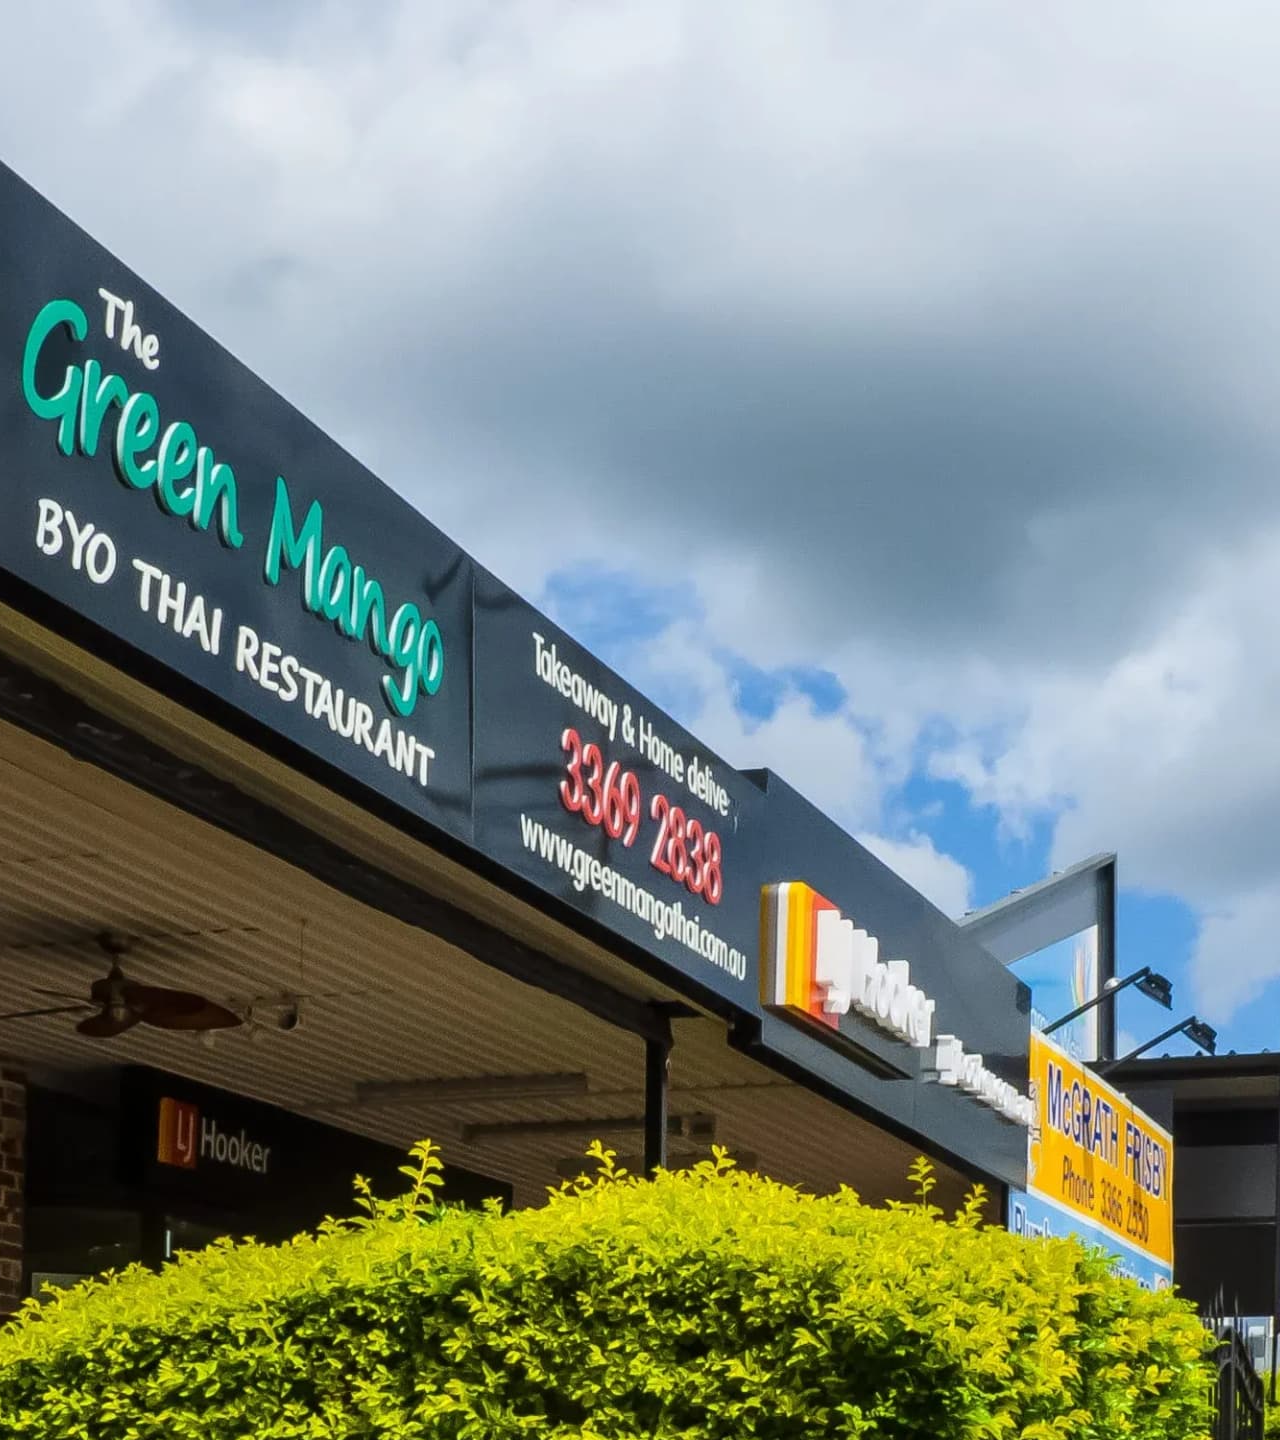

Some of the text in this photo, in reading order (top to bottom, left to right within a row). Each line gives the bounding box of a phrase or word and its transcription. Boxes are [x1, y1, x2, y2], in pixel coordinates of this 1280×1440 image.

[98, 287, 160, 370] The
[22, 299, 444, 717] Green Mango
[36, 498, 435, 786] BYO THAI RESTAURANT
[532, 632, 618, 741] Takeaway
[621, 704, 635, 747] &
[639, 716, 684, 783] Home
[560, 728, 722, 906] 3369 2838
[520, 813, 746, 982] www.greenmangothai.com.au
[200, 1116, 271, 1175] Hooker
[1047, 1062, 1119, 1168] McGRATH
[1124, 1119, 1168, 1201] FRISBY
[1062, 1155, 1095, 1211] Phone
